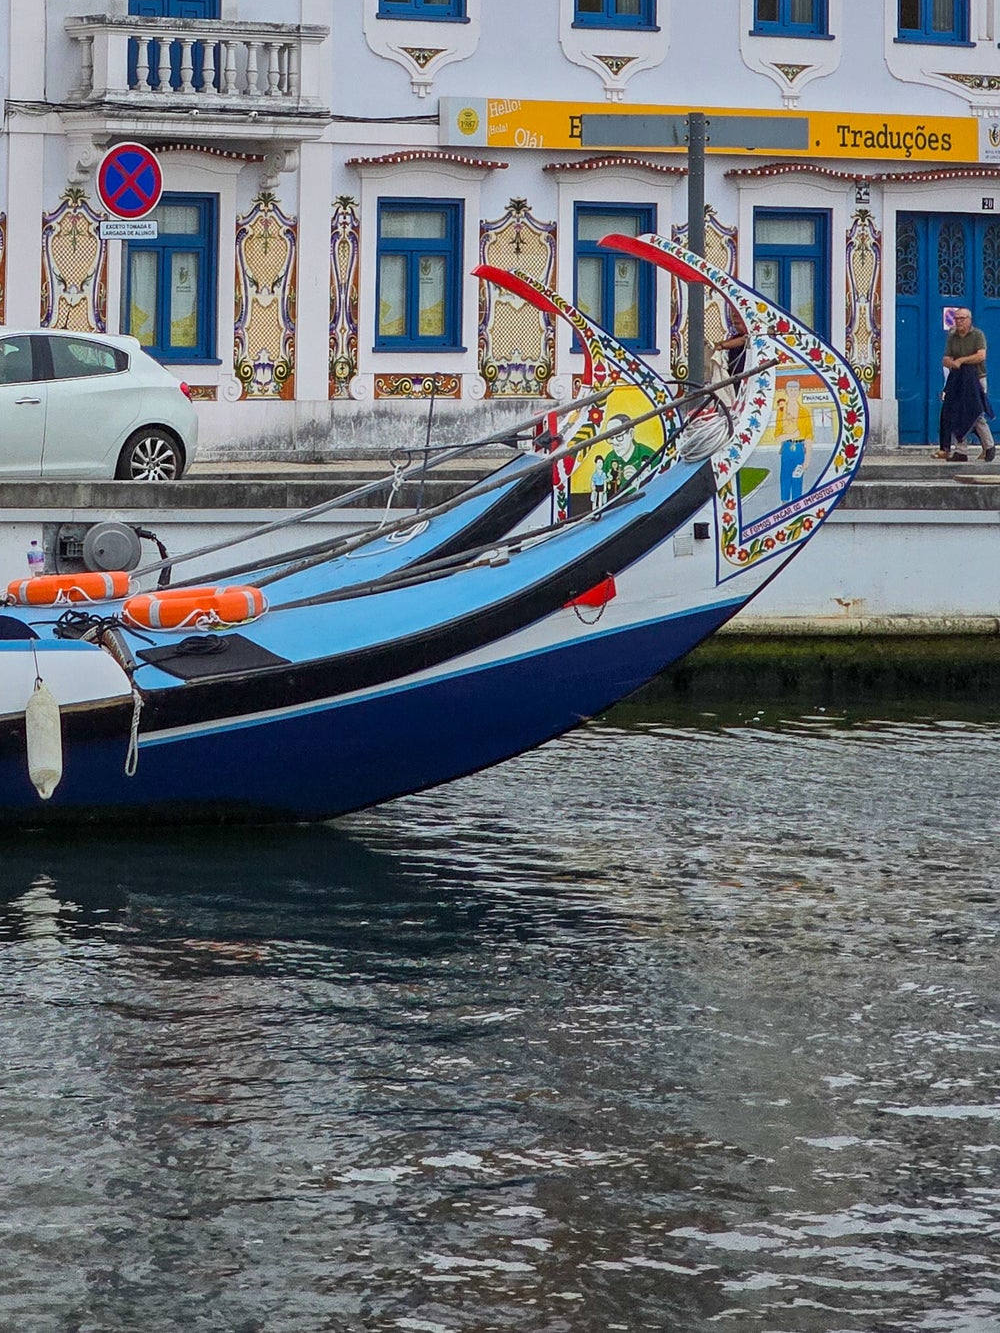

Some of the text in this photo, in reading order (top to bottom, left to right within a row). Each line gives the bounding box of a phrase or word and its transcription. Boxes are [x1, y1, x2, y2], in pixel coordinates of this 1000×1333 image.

[490, 100, 521, 118] Hello!
[461, 120, 476, 128] 1987
[837, 123, 952, 158] Traduções
[749, 520, 772, 535] FOMOS
[803, 486, 834, 506] IMPOSTOS
